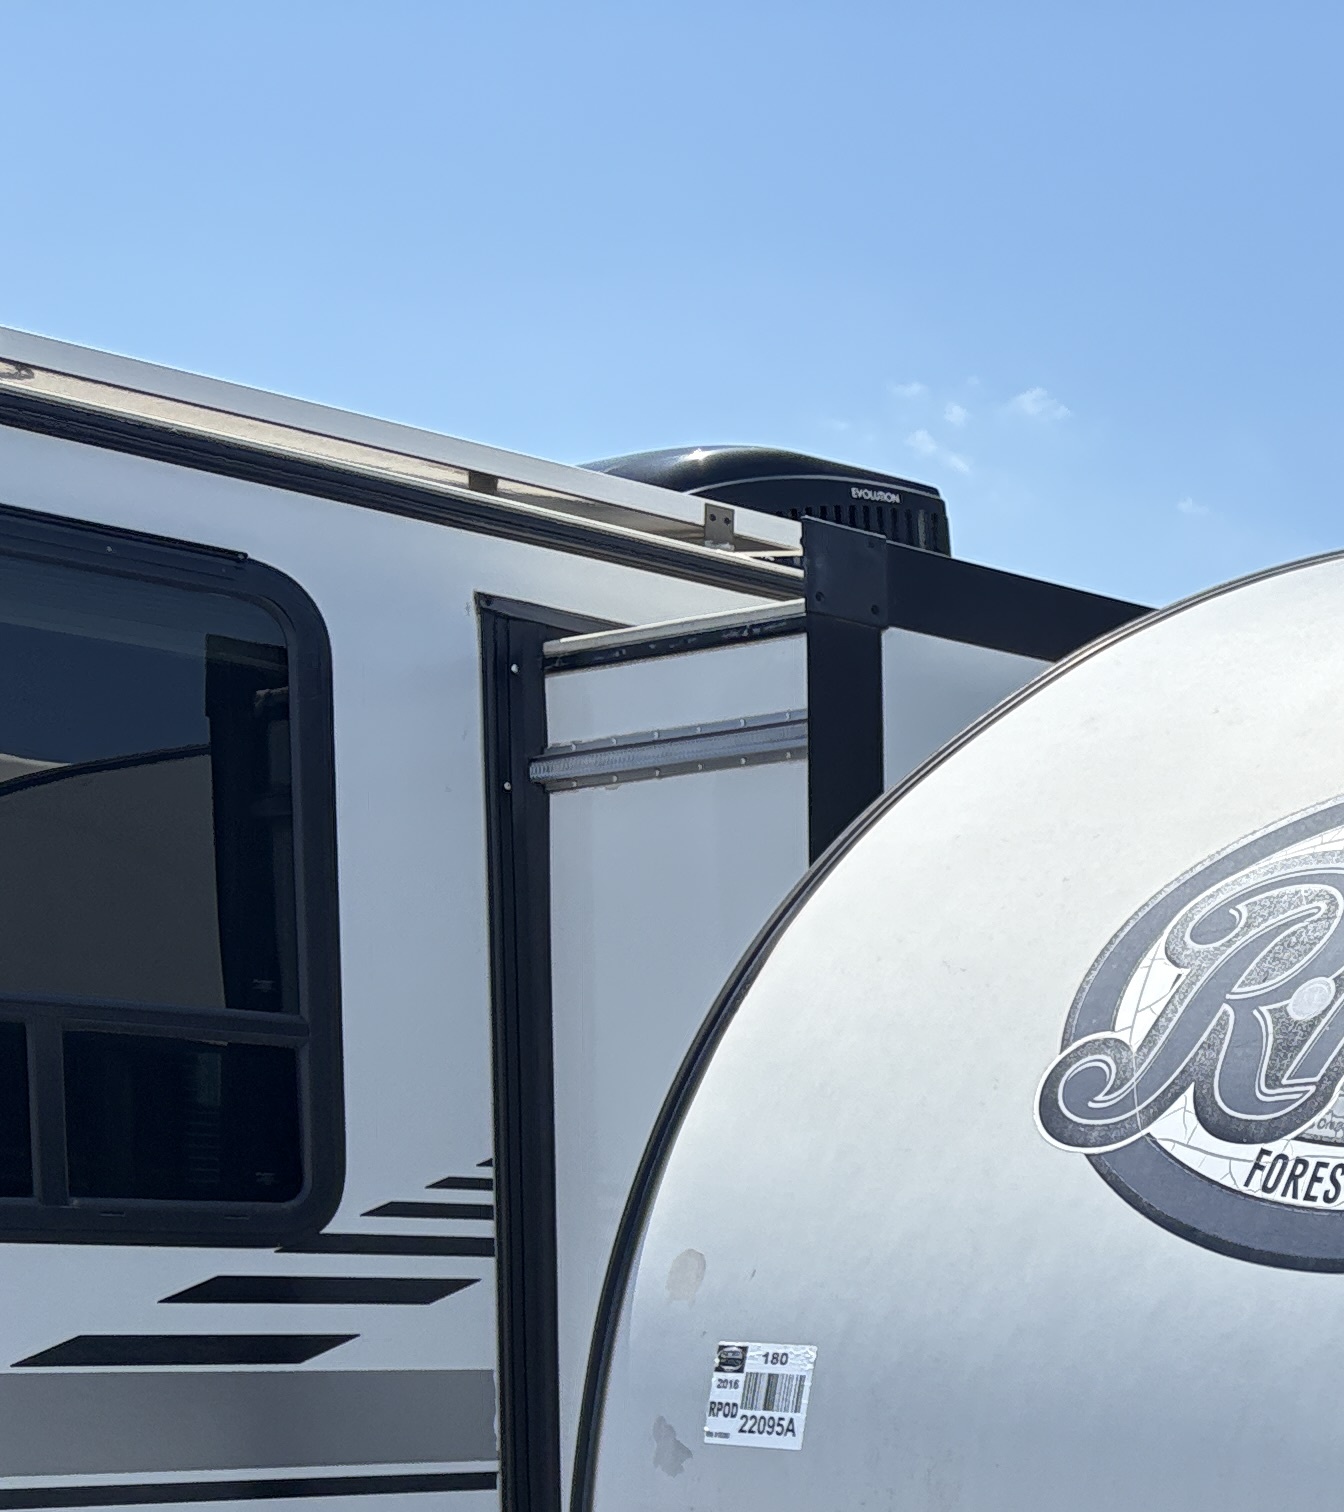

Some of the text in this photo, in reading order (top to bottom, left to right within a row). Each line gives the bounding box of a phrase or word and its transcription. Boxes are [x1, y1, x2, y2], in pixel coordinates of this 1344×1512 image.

[762, 1352, 789, 1365] 180
[708, 1401, 739, 1418] RPOD
[738, 1415, 797, 1437] 22095A
